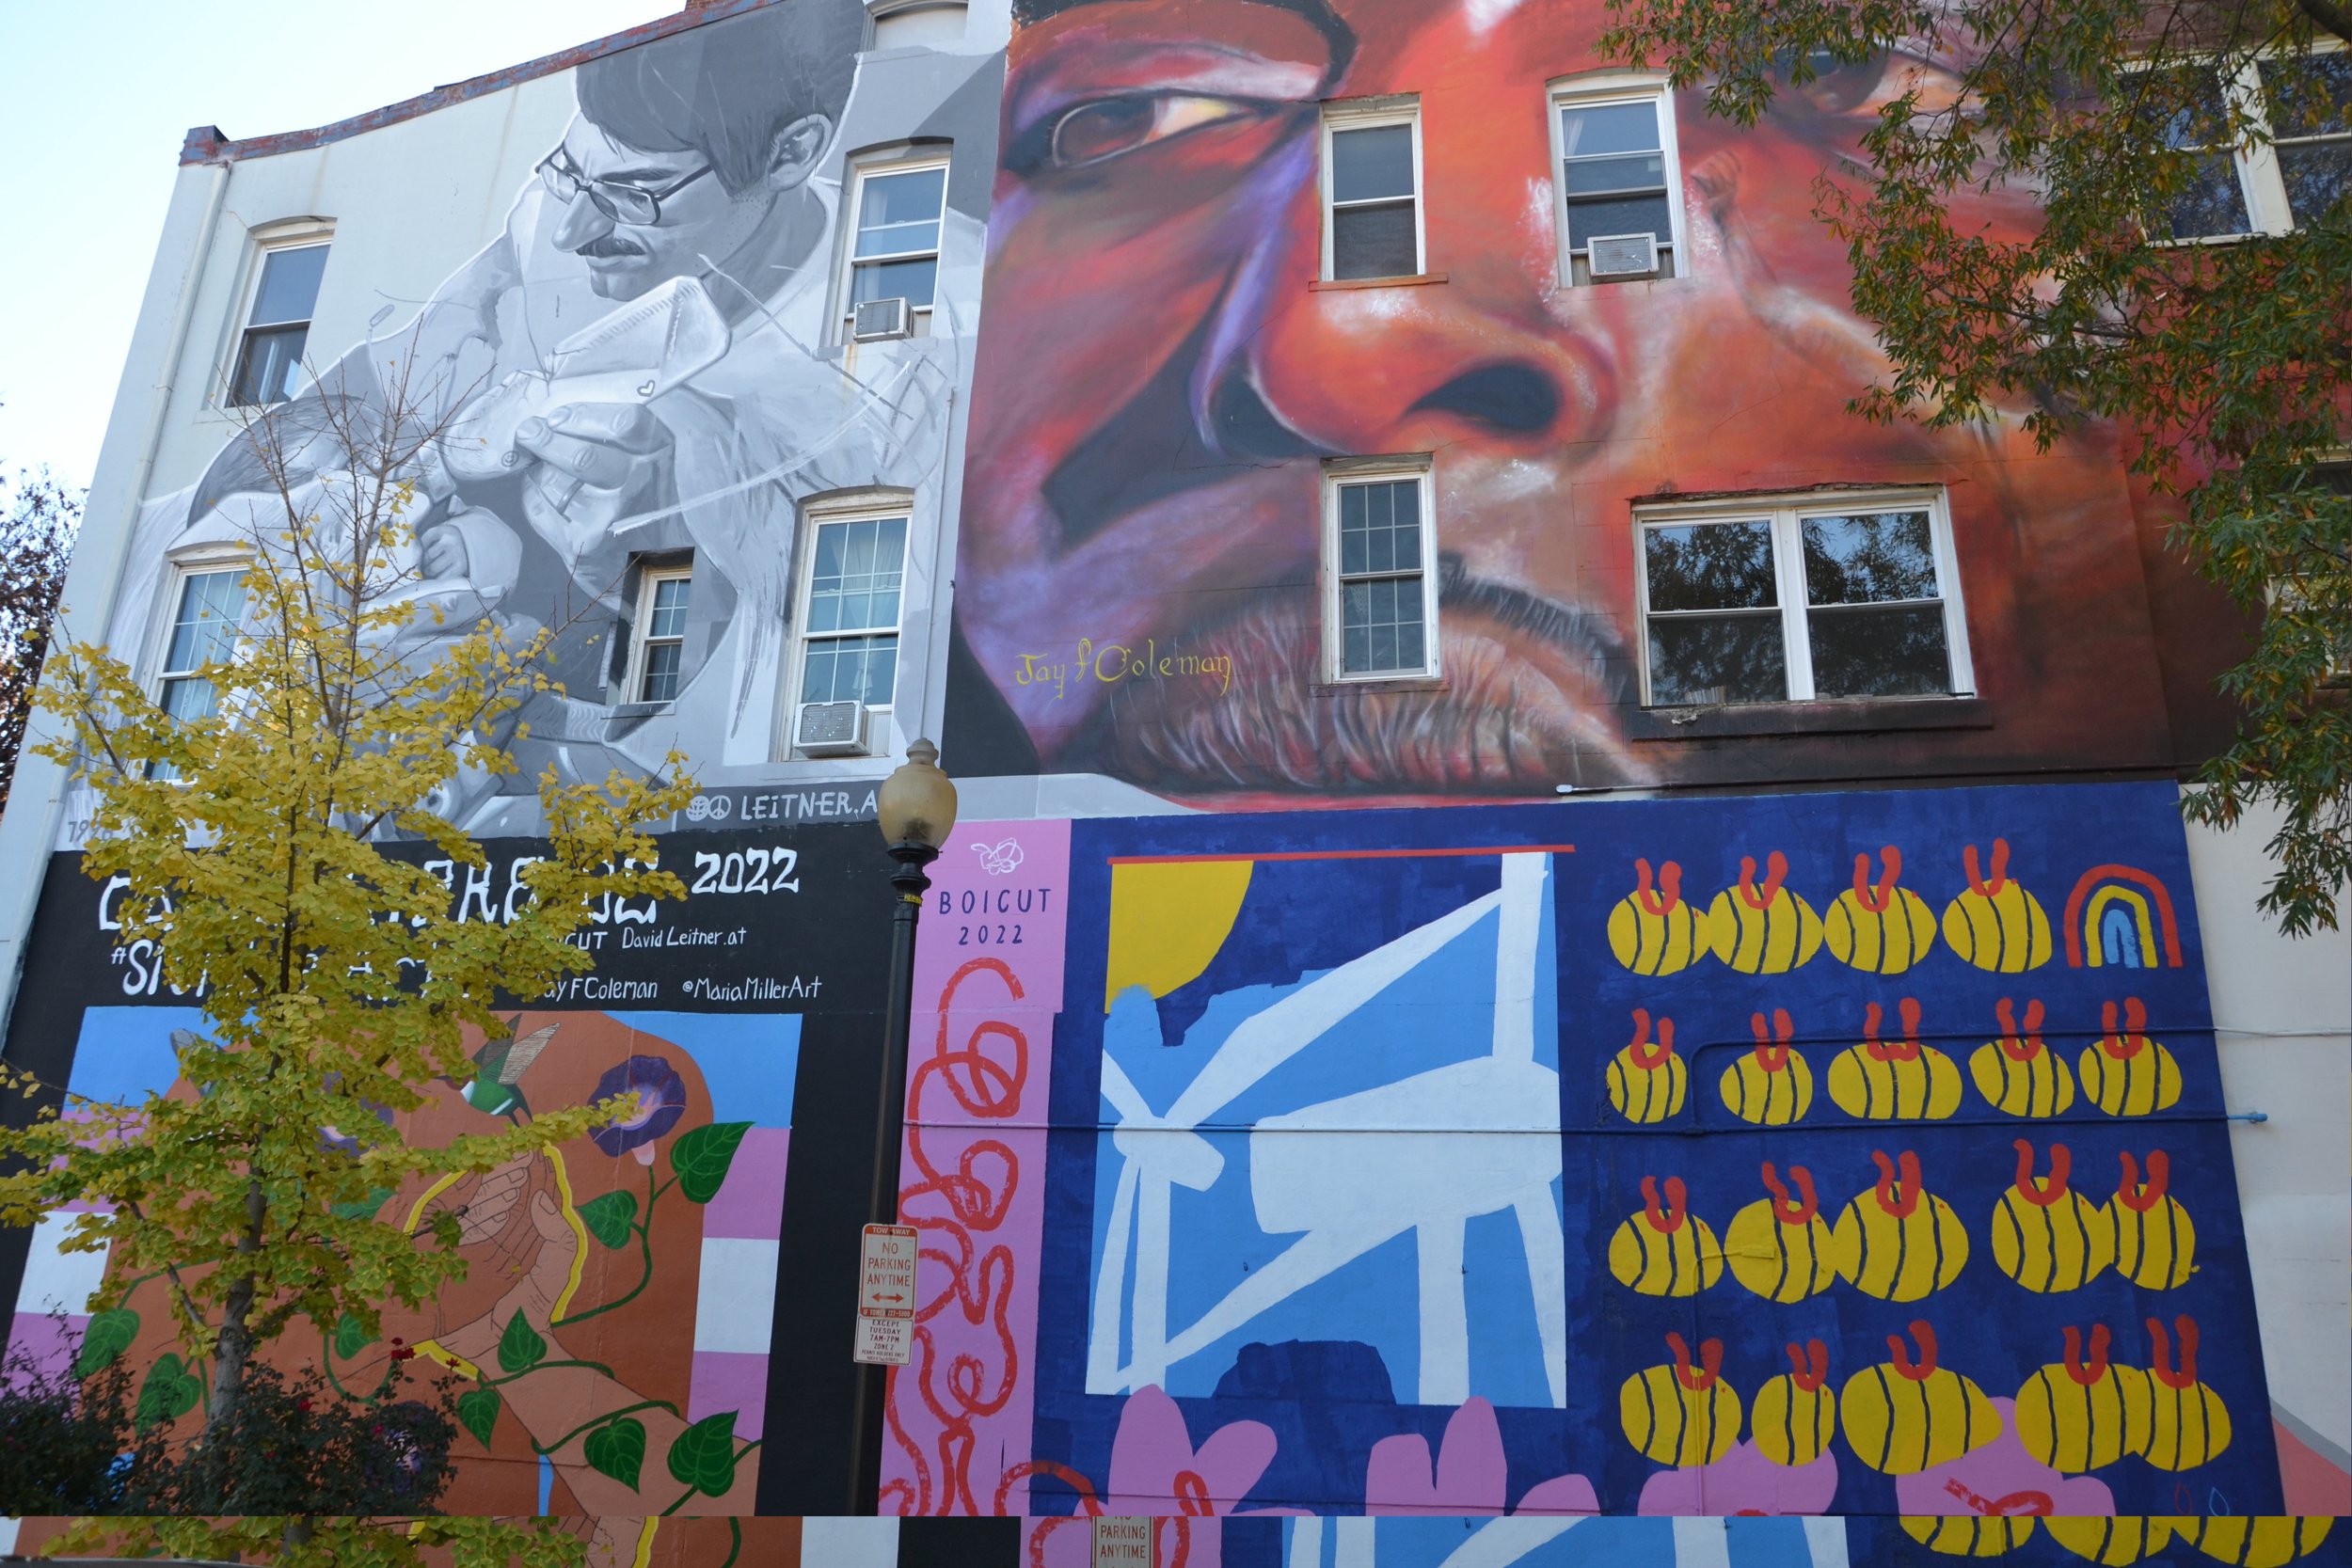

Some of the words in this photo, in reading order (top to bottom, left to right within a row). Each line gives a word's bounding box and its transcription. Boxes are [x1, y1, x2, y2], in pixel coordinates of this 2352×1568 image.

[1015, 653, 1066, 700] Jay
[1095, 639, 1232, 696] Coleman
[691, 847, 800, 895] 2022
[939, 889, 1052, 914] BOICUT
[958, 925, 1023, 945] 2022
[682, 975, 823, 1002] @MariaMillerArt
[882, 1242, 898, 1255] NO
[867, 1258, 911, 1271] PARKING
[866, 1274, 911, 1287] ANYTIME
[872, 1319, 899, 1327] EXCEPT
[869, 1326, 901, 1336] TUESDAY
[870, 1334, 899, 1343] 7AM-7PM
[1100, 1525, 1146, 1540] PARKING
[1100, 1544, 1146, 1559] ANYTIME
